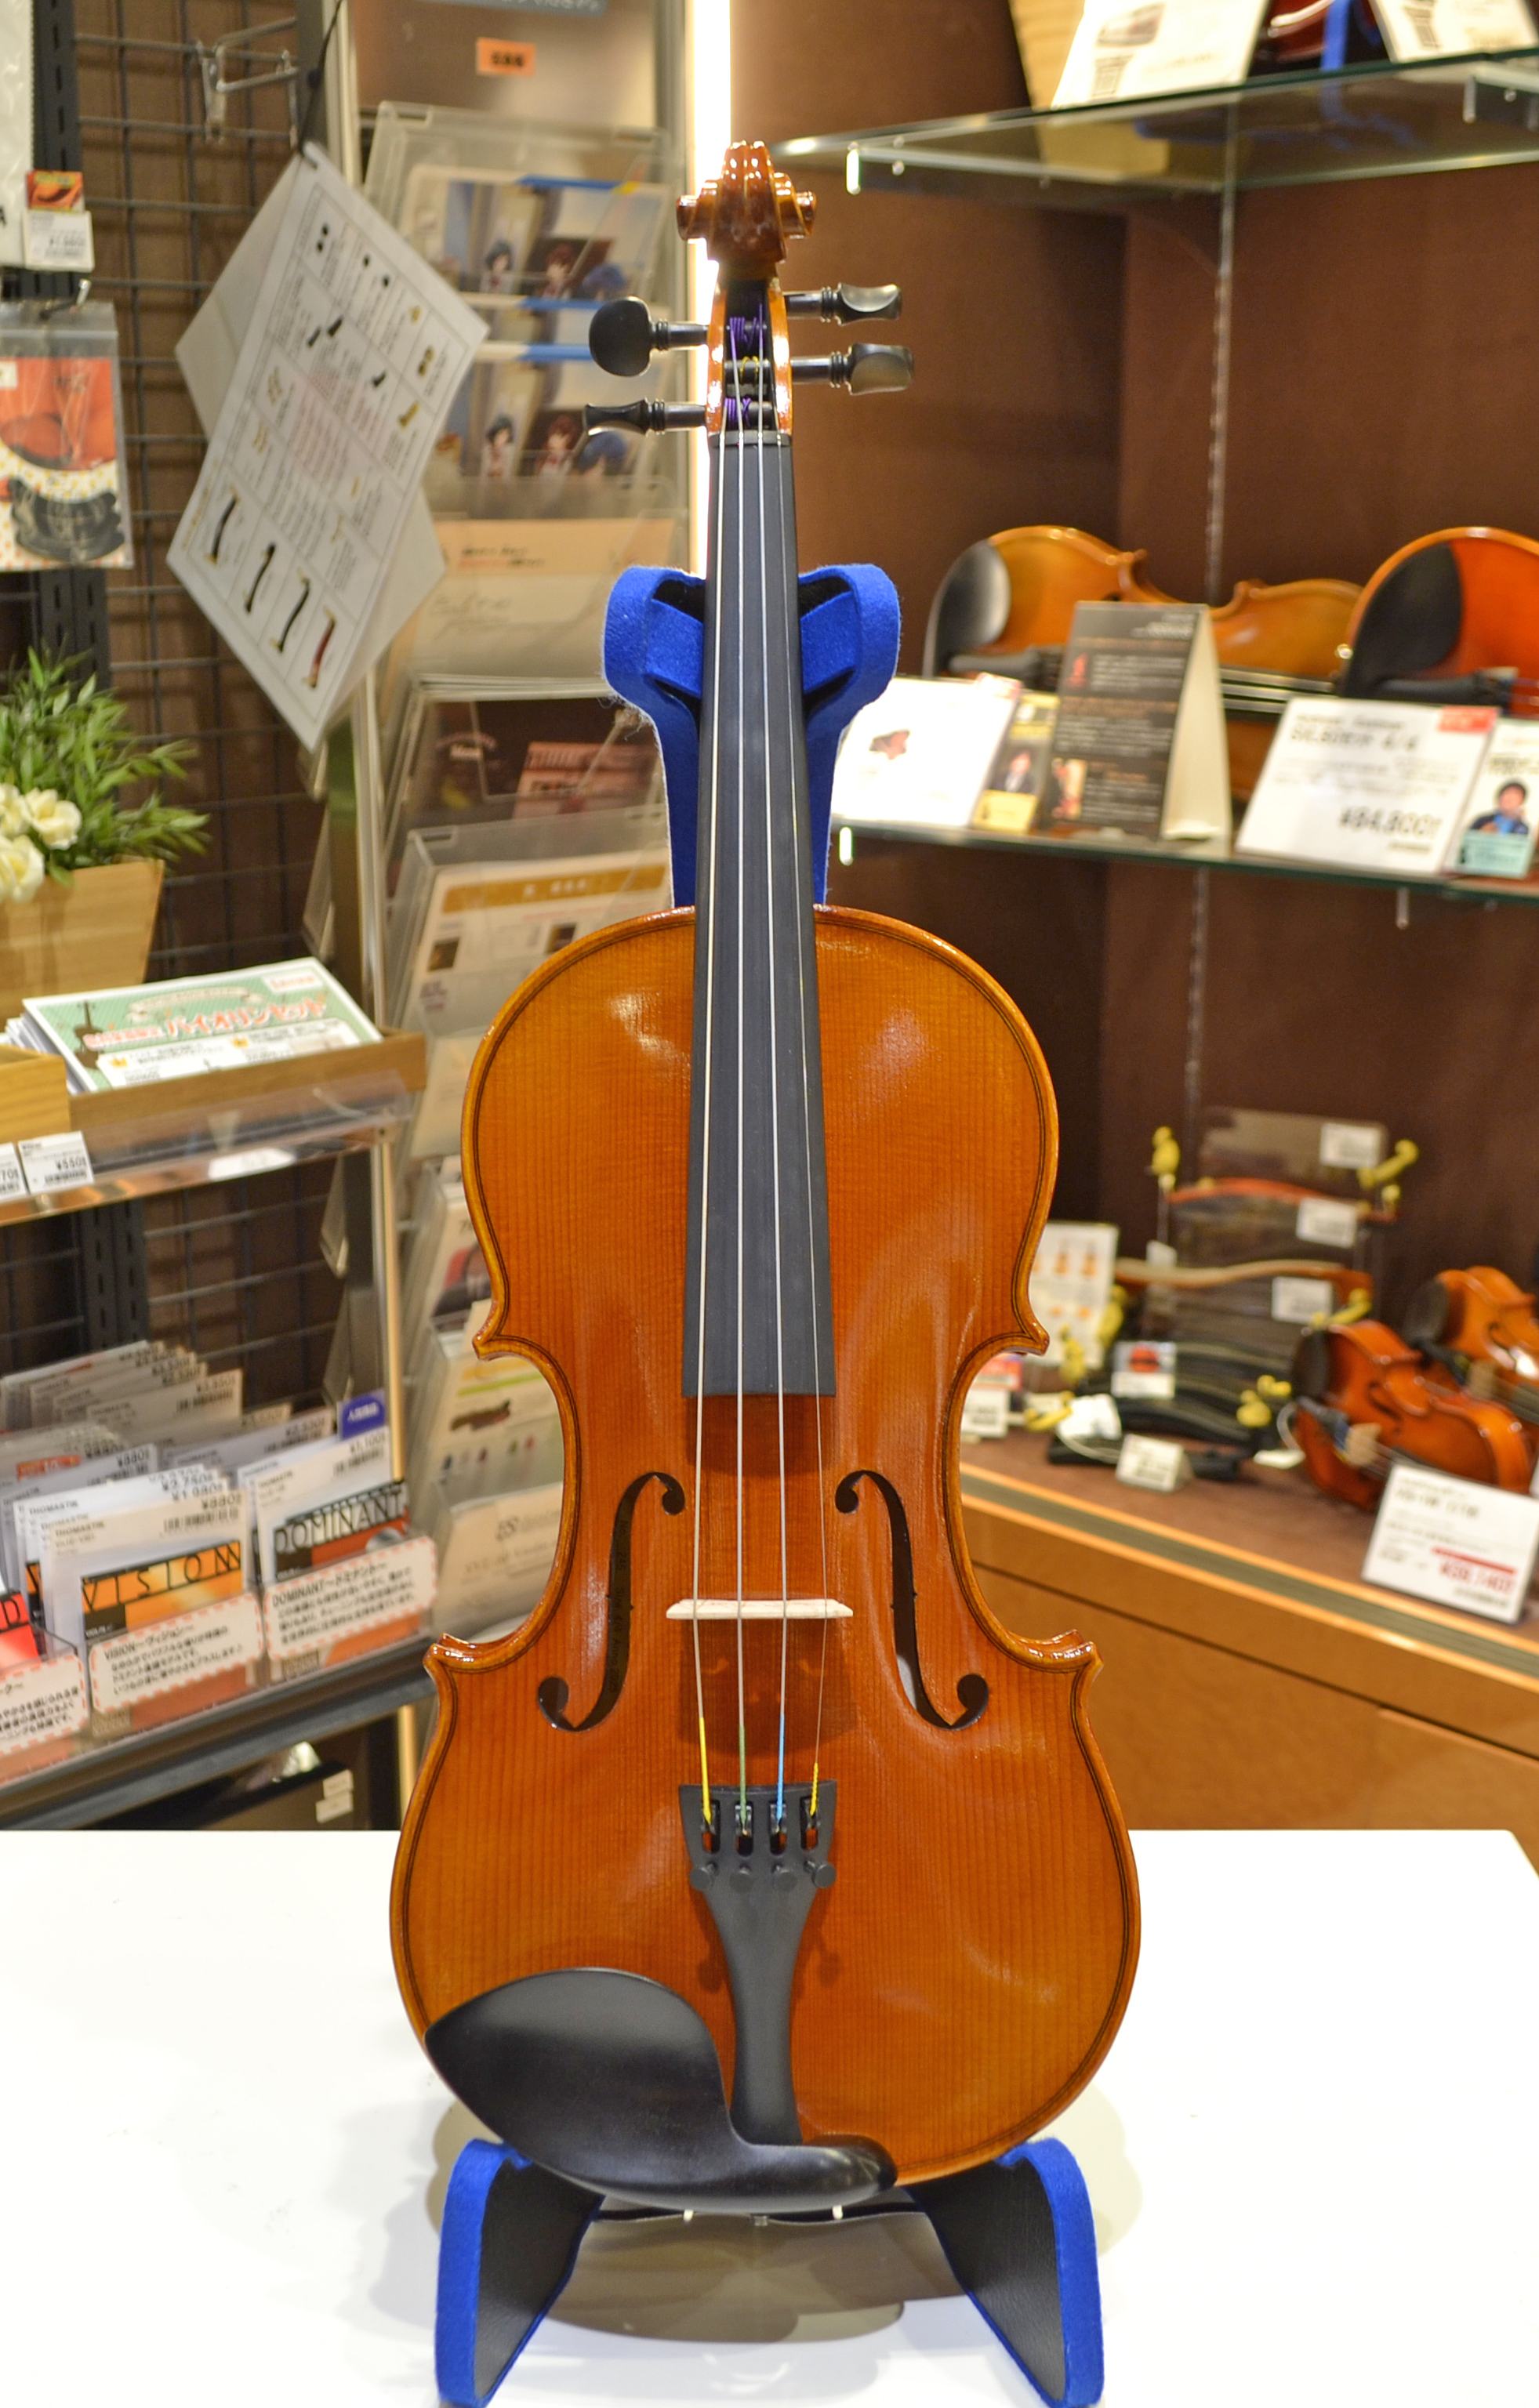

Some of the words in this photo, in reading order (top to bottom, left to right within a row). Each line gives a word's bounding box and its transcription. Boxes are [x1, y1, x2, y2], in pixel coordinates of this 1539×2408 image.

[165, 998, 327, 1038] バイオリンセット
[274, 1485, 405, 1553] DOMINANT
[82, 1541, 241, 1611] VISION
